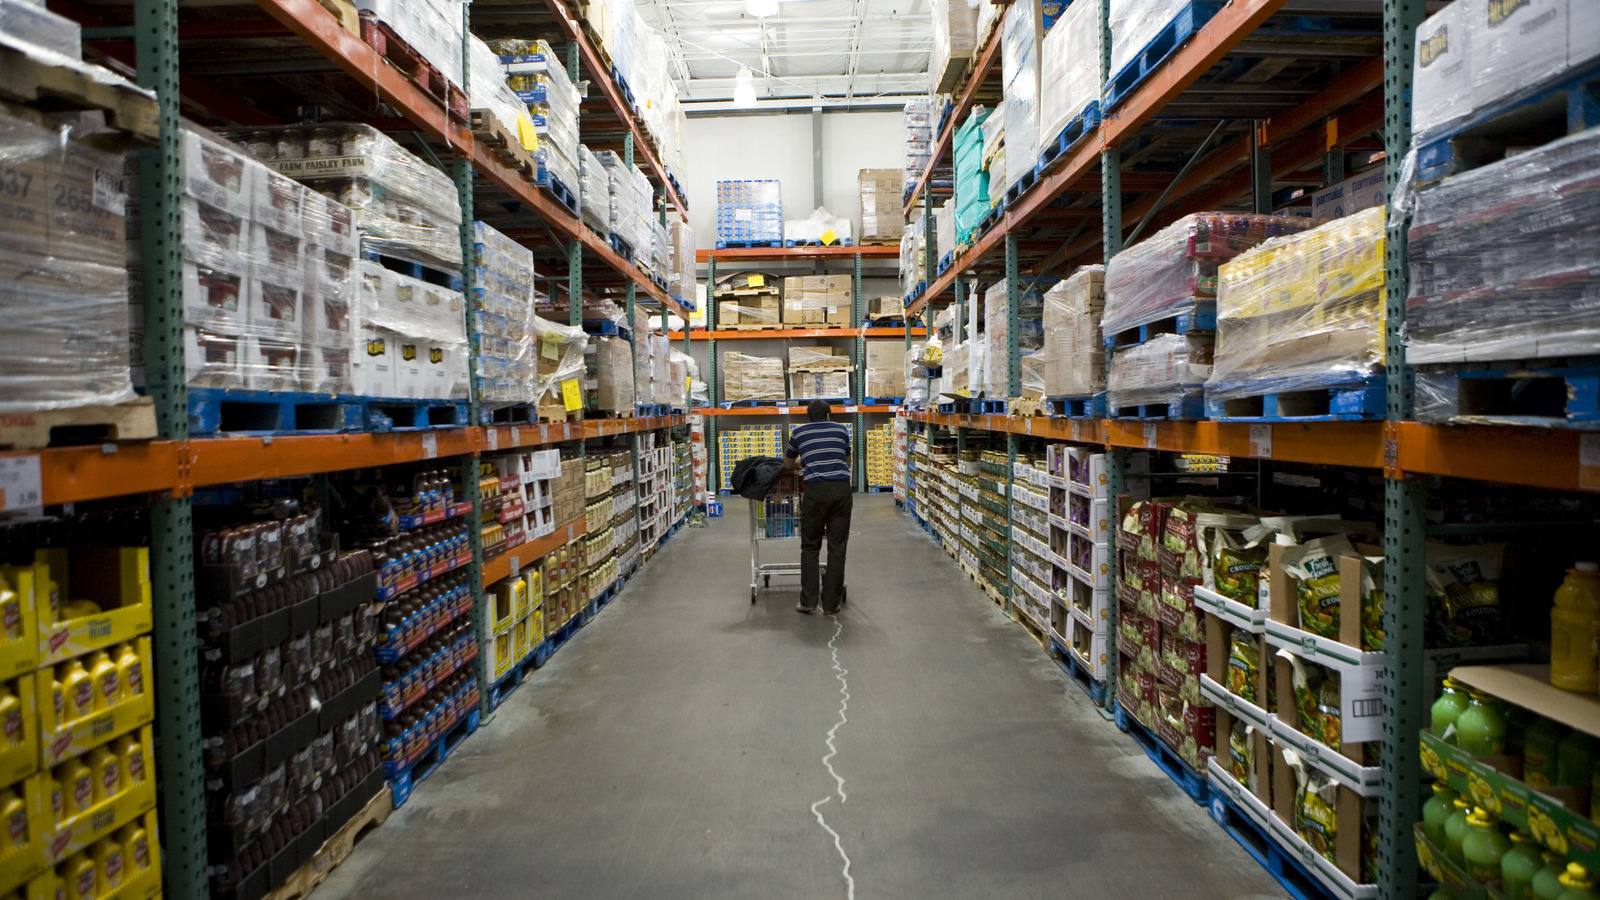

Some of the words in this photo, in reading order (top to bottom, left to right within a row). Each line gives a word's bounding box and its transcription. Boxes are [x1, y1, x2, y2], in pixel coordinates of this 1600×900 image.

[280, 162, 302, 171] FARM
[305, 160, 339, 170] PAISLEY
[342, 158, 365, 167] FARM
[0, 168, 32, 197] 37
[1352, 169, 1385, 194] parmalat
[1316, 186, 1344, 209] parmalat
